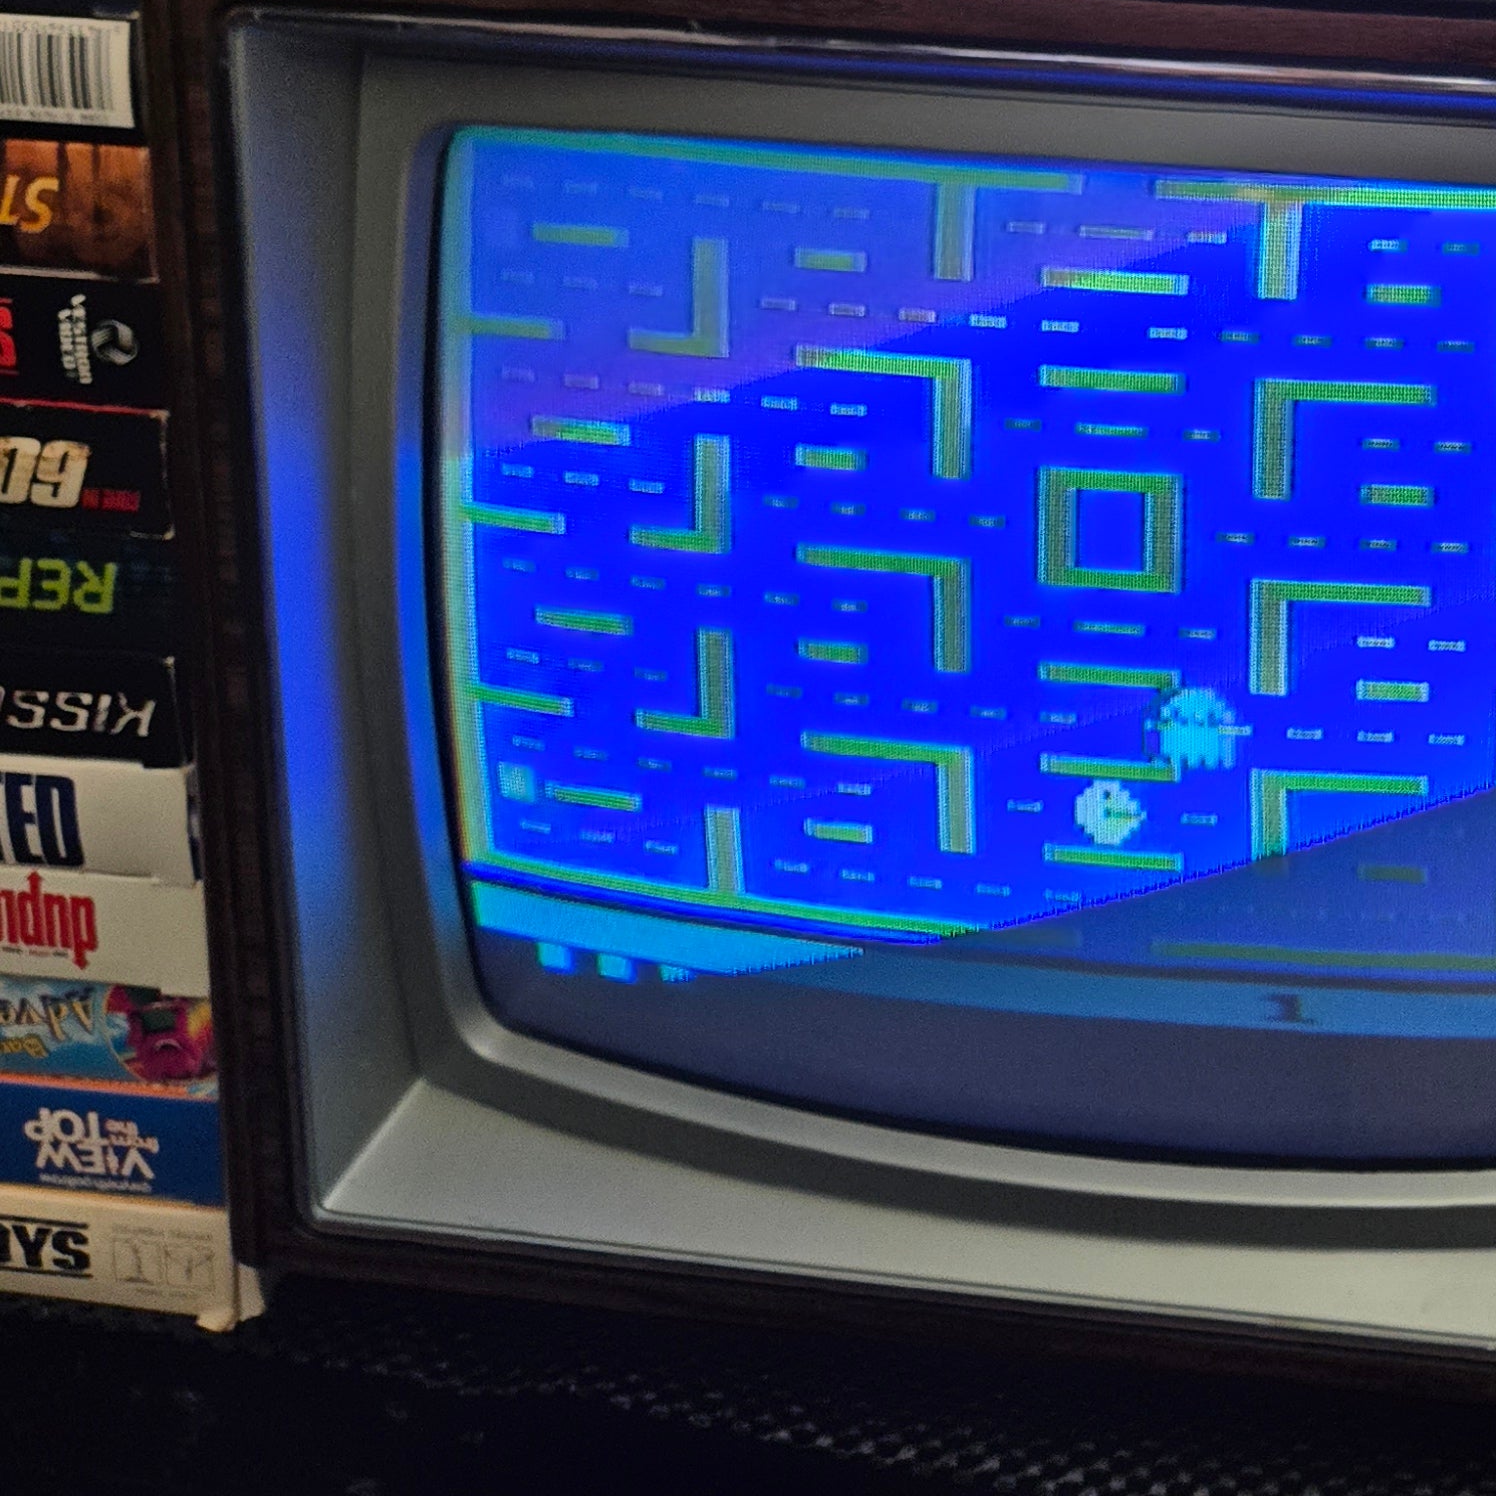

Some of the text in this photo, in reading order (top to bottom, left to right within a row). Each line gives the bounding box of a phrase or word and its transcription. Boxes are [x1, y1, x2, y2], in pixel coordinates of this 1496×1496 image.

[0, 686, 156, 737] KISS
[0, 771, 85, 867] ED
[23, 1106, 102, 1146] TOP
[35, 1141, 156, 1180] VIEW
